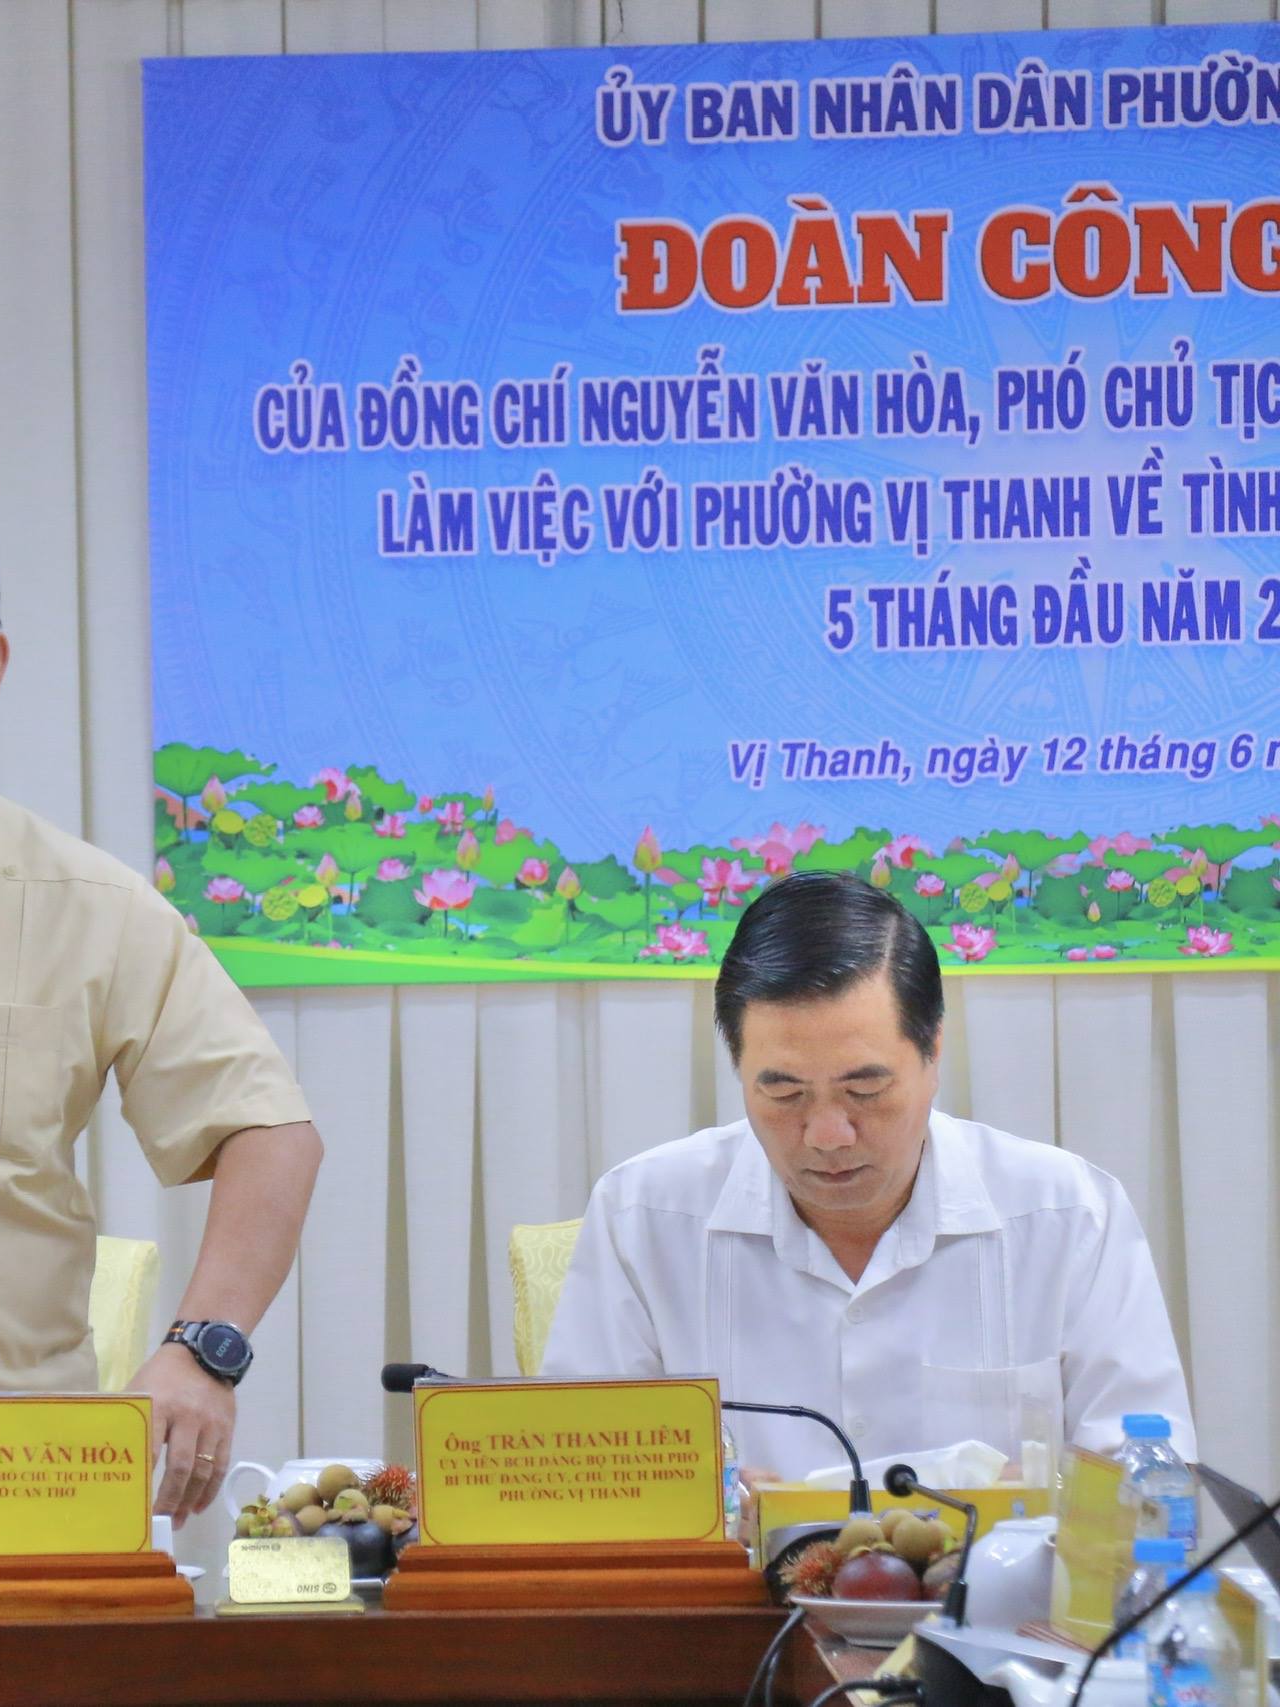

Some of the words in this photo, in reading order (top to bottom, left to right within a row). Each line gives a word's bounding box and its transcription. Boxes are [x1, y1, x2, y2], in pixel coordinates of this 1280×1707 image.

[600, 70, 672, 142] ỦY
[689, 84, 795, 140] BAN
[813, 66, 958, 135] NHÂN
[978, 62, 1088, 131] DÂN
[619, 198, 950, 312] ĐOÀN
[257, 363, 346, 450] CỦA
[358, 357, 480, 448] ĐỒNG
[492, 364, 567, 444] CHÍ
[581, 347, 756, 443] NGUYỄN
[768, 362, 861, 438] VĂN
[875, 354, 981, 446] HÒA,
[995, 348, 1088, 433] PHÓ
[1103, 339, 1194, 430] CHỦ
[380, 474, 475, 553] LÀM
[487, 472, 590, 564] VIỆC
[602, 468, 679, 549] VỚI
[694, 466, 873, 548] PHƯỜNG
[884, 479, 929, 556] VỊ
[942, 475, 1092, 541] THANH
[1106, 445, 1165, 537] VỀ
[1181, 455, 1280, 534] TÌNH
[826, 588, 855, 651] 5
[867, 569, 1019, 649] THÁNG
[1031, 555, 1125, 645] ĐẦU
[1140, 566, 1242, 643] NĂM
[730, 742, 767, 787] Vị
[781, 739, 912, 784] Thanh,
[926, 737, 1028, 784] ngày
[1042, 736, 1088, 772] 12
[1098, 733, 1217, 780] tháng
[1228, 732, 1255, 770] 6
[22, 1442, 73, 1464] VĂN
[81, 1441, 134, 1464] HÒA
[445, 1432, 481, 1453] Ông
[554, 1430, 629, 1449] THANH
